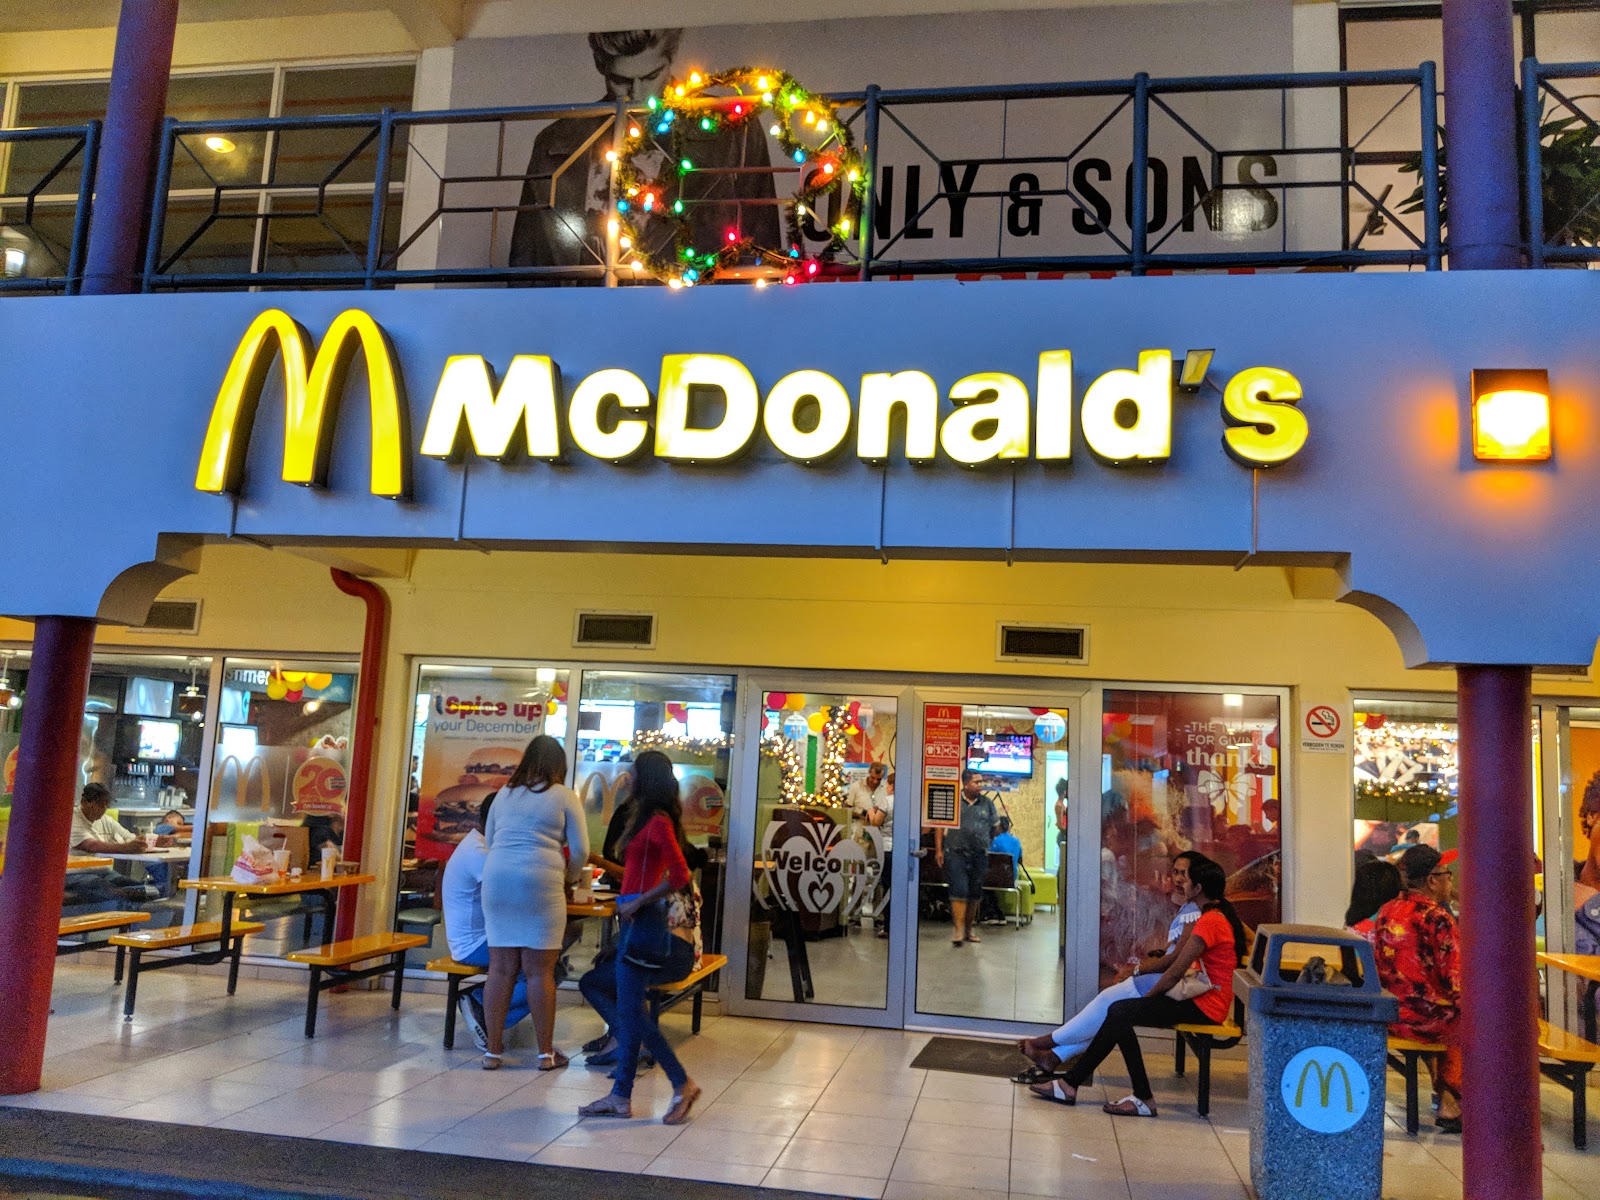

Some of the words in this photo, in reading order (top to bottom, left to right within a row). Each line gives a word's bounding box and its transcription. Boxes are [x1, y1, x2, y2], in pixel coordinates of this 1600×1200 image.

[802, 161, 980, 242] ONLY
[1007, 173, 1043, 237] &
[1072, 154, 1279, 235] SONS
[420, 347, 1308, 463] McDonald's
[445, 695, 508, 719] Spice
[513, 702, 543, 721] up
[434, 720, 462, 733] your
[466, 719, 541, 734] December!
[1190, 721, 1217, 732] THE
[1187, 733, 1215, 745] FOR
[1186, 747, 1268, 769] thanks
[765, 850, 881, 876] Welcome
